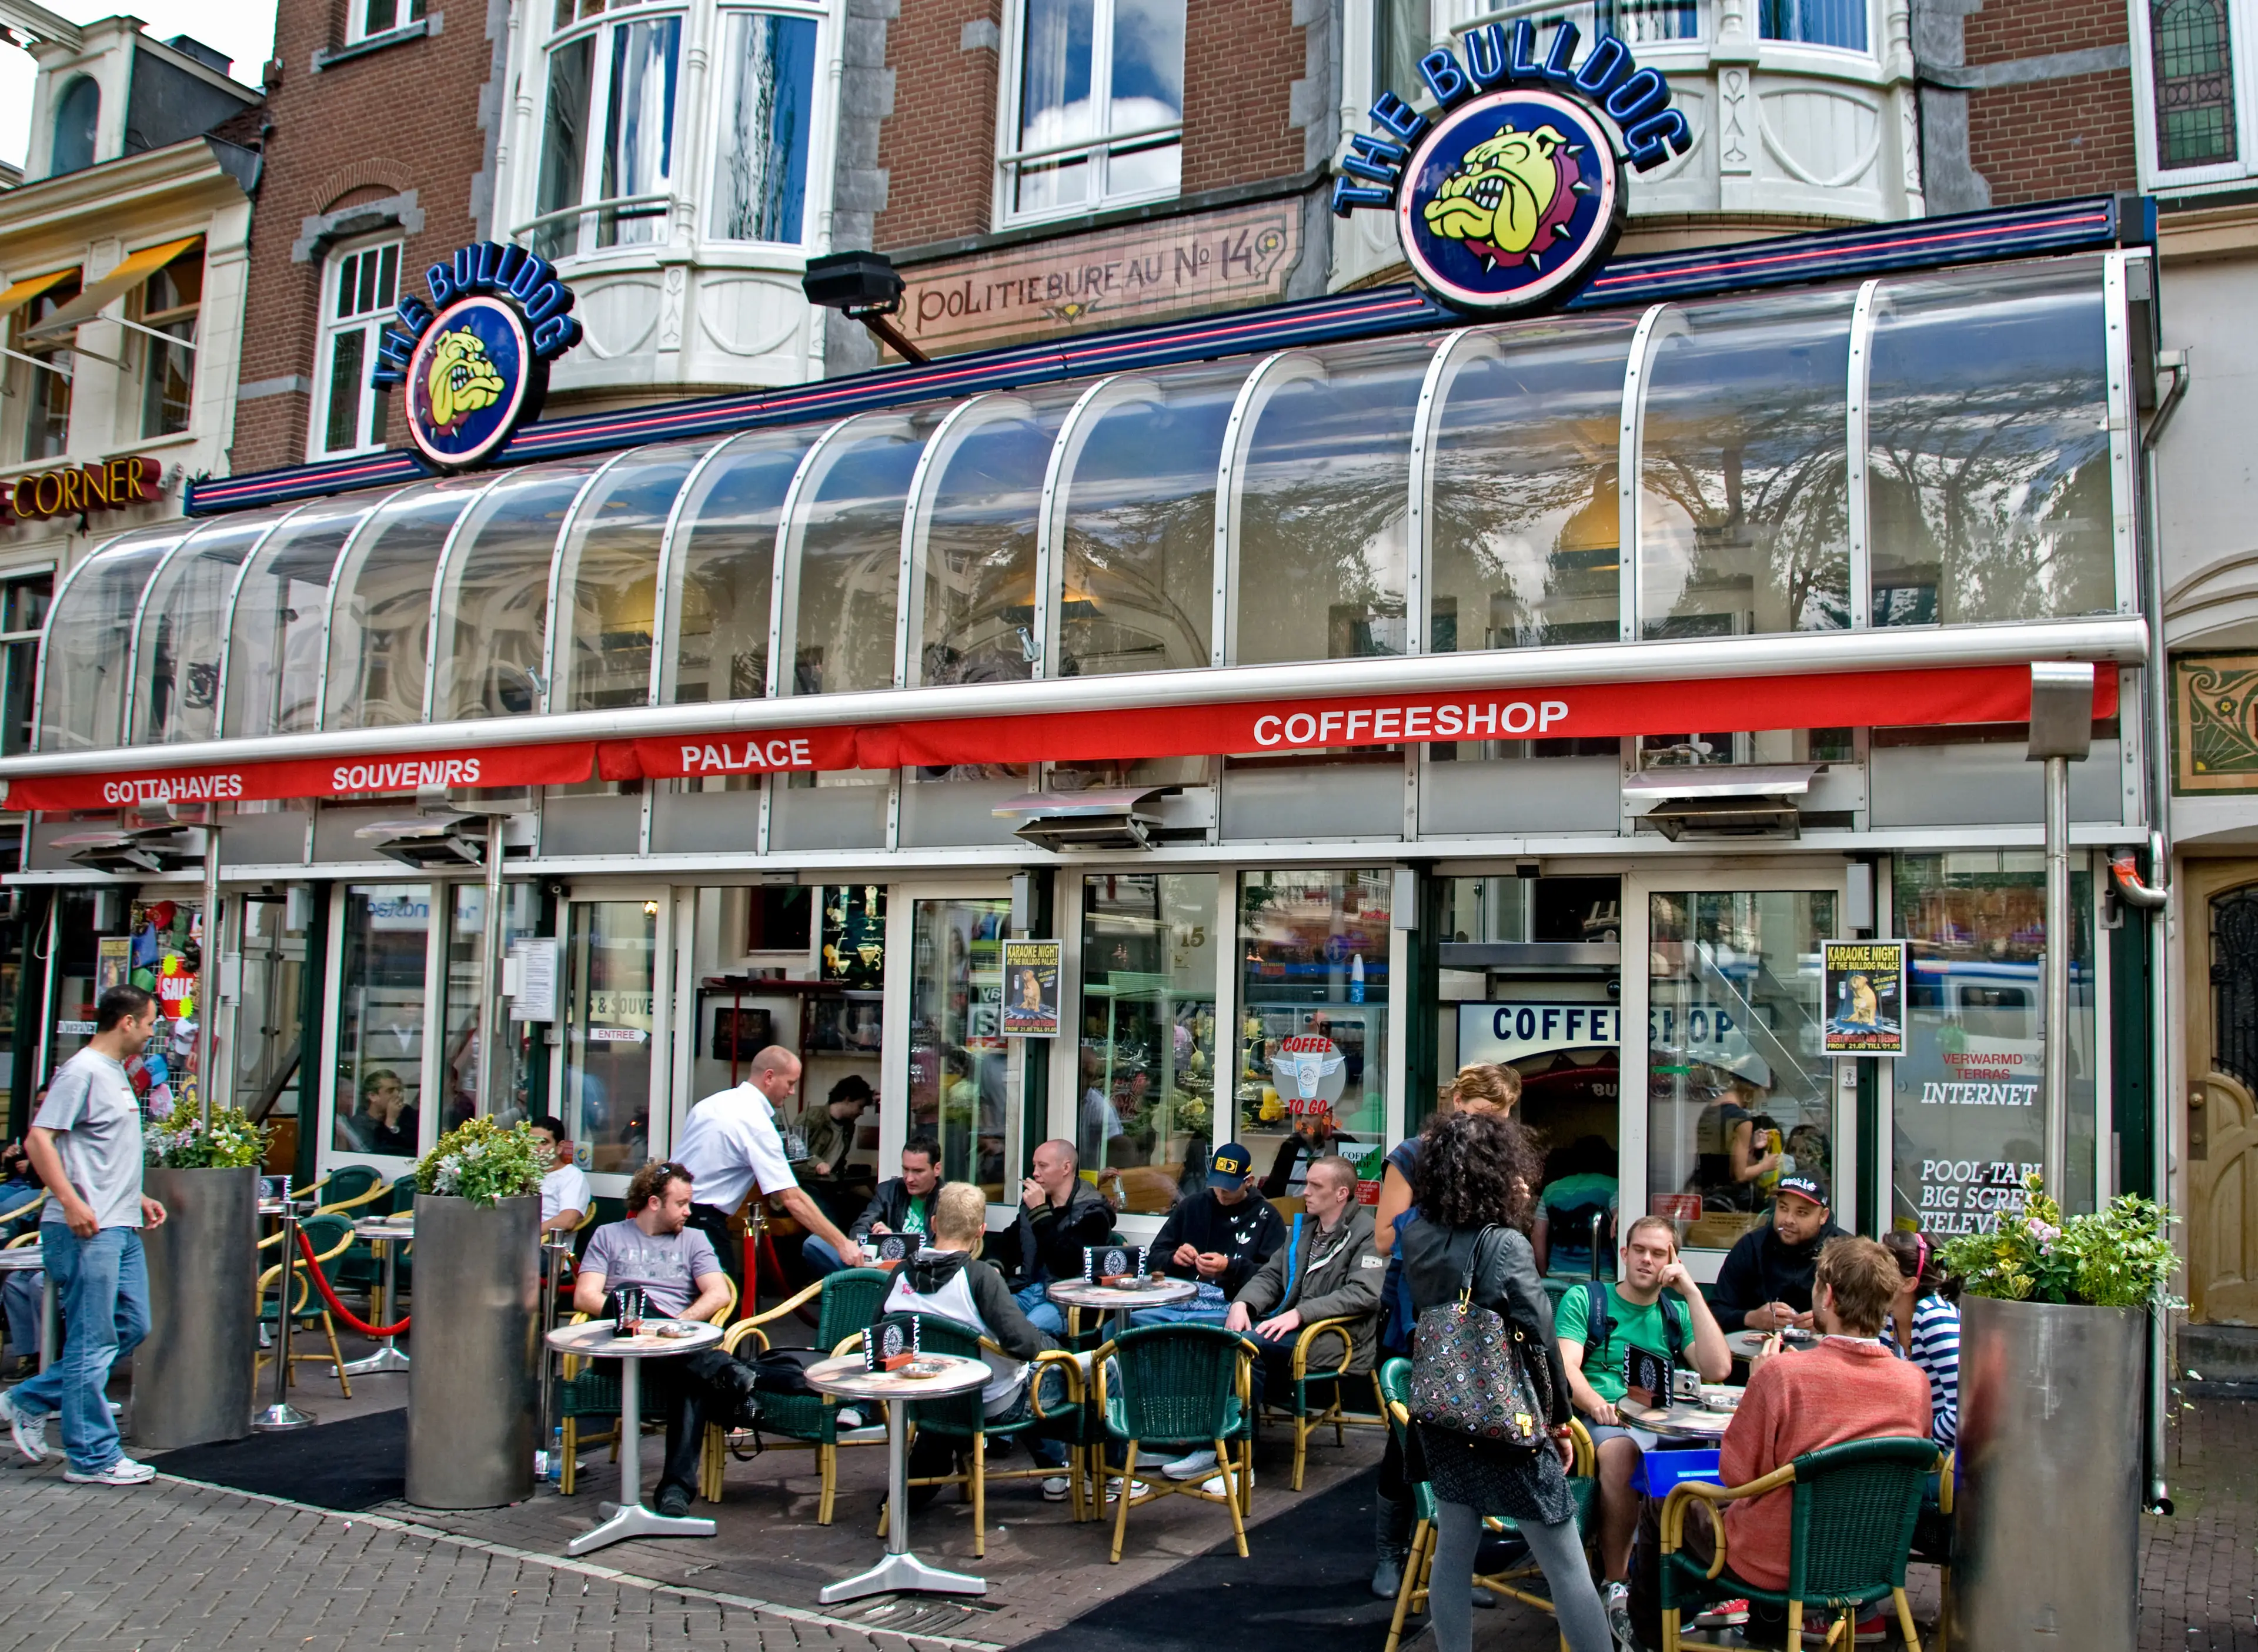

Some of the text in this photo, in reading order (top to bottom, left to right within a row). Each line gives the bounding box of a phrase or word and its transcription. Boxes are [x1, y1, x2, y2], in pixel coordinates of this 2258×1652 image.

[1331, 19, 1692, 218] THE BULLDOG
[916, 253, 1163, 333] POLITIEBUREAU
[1221, 228, 1252, 281] 14
[370, 240, 583, 392] THE BULLDOG
[13, 458, 143, 518] CORNER
[1253, 701, 1569, 746] COFFEESHOP
[680, 738, 812, 772] PALACE
[103, 774, 243, 804] GOTTAHAVES
[332, 758, 480, 791] SOUVENIRS
[1007, 945, 1058, 958] KARAOKE NIGHT
[1828, 947, 1900, 962] KARAOKE NIGHT
[1849, 962, 1876, 970] BULLDOG
[1877, 962, 1900, 970] PALACE
[599, 1030, 635, 1039] ENTREE
[1283, 1037, 1334, 1052] COFFEE
[1828, 1035, 1843, 1043] EVERY
[1866, 1035, 1877, 1043] AND
[1943, 1054, 2023, 1065] VERWARMD
[1956, 1068, 2010, 1079] TERRAS
[1289, 1099, 1328, 1115] TO GO
[1920, 1082, 2038, 1106] INTERNET
[1342, 1151, 1377, 1161] COFFEE
[1920, 1186, 1960, 1208] BIG
[1084, 1246, 1092, 1282] MENU
[1137, 1246, 1145, 1280] PALACE
[863, 1327, 873, 1372] MENU
[912, 1314, 920, 1359] PALACE
[1664, 1360, 1672, 1407] MENU
